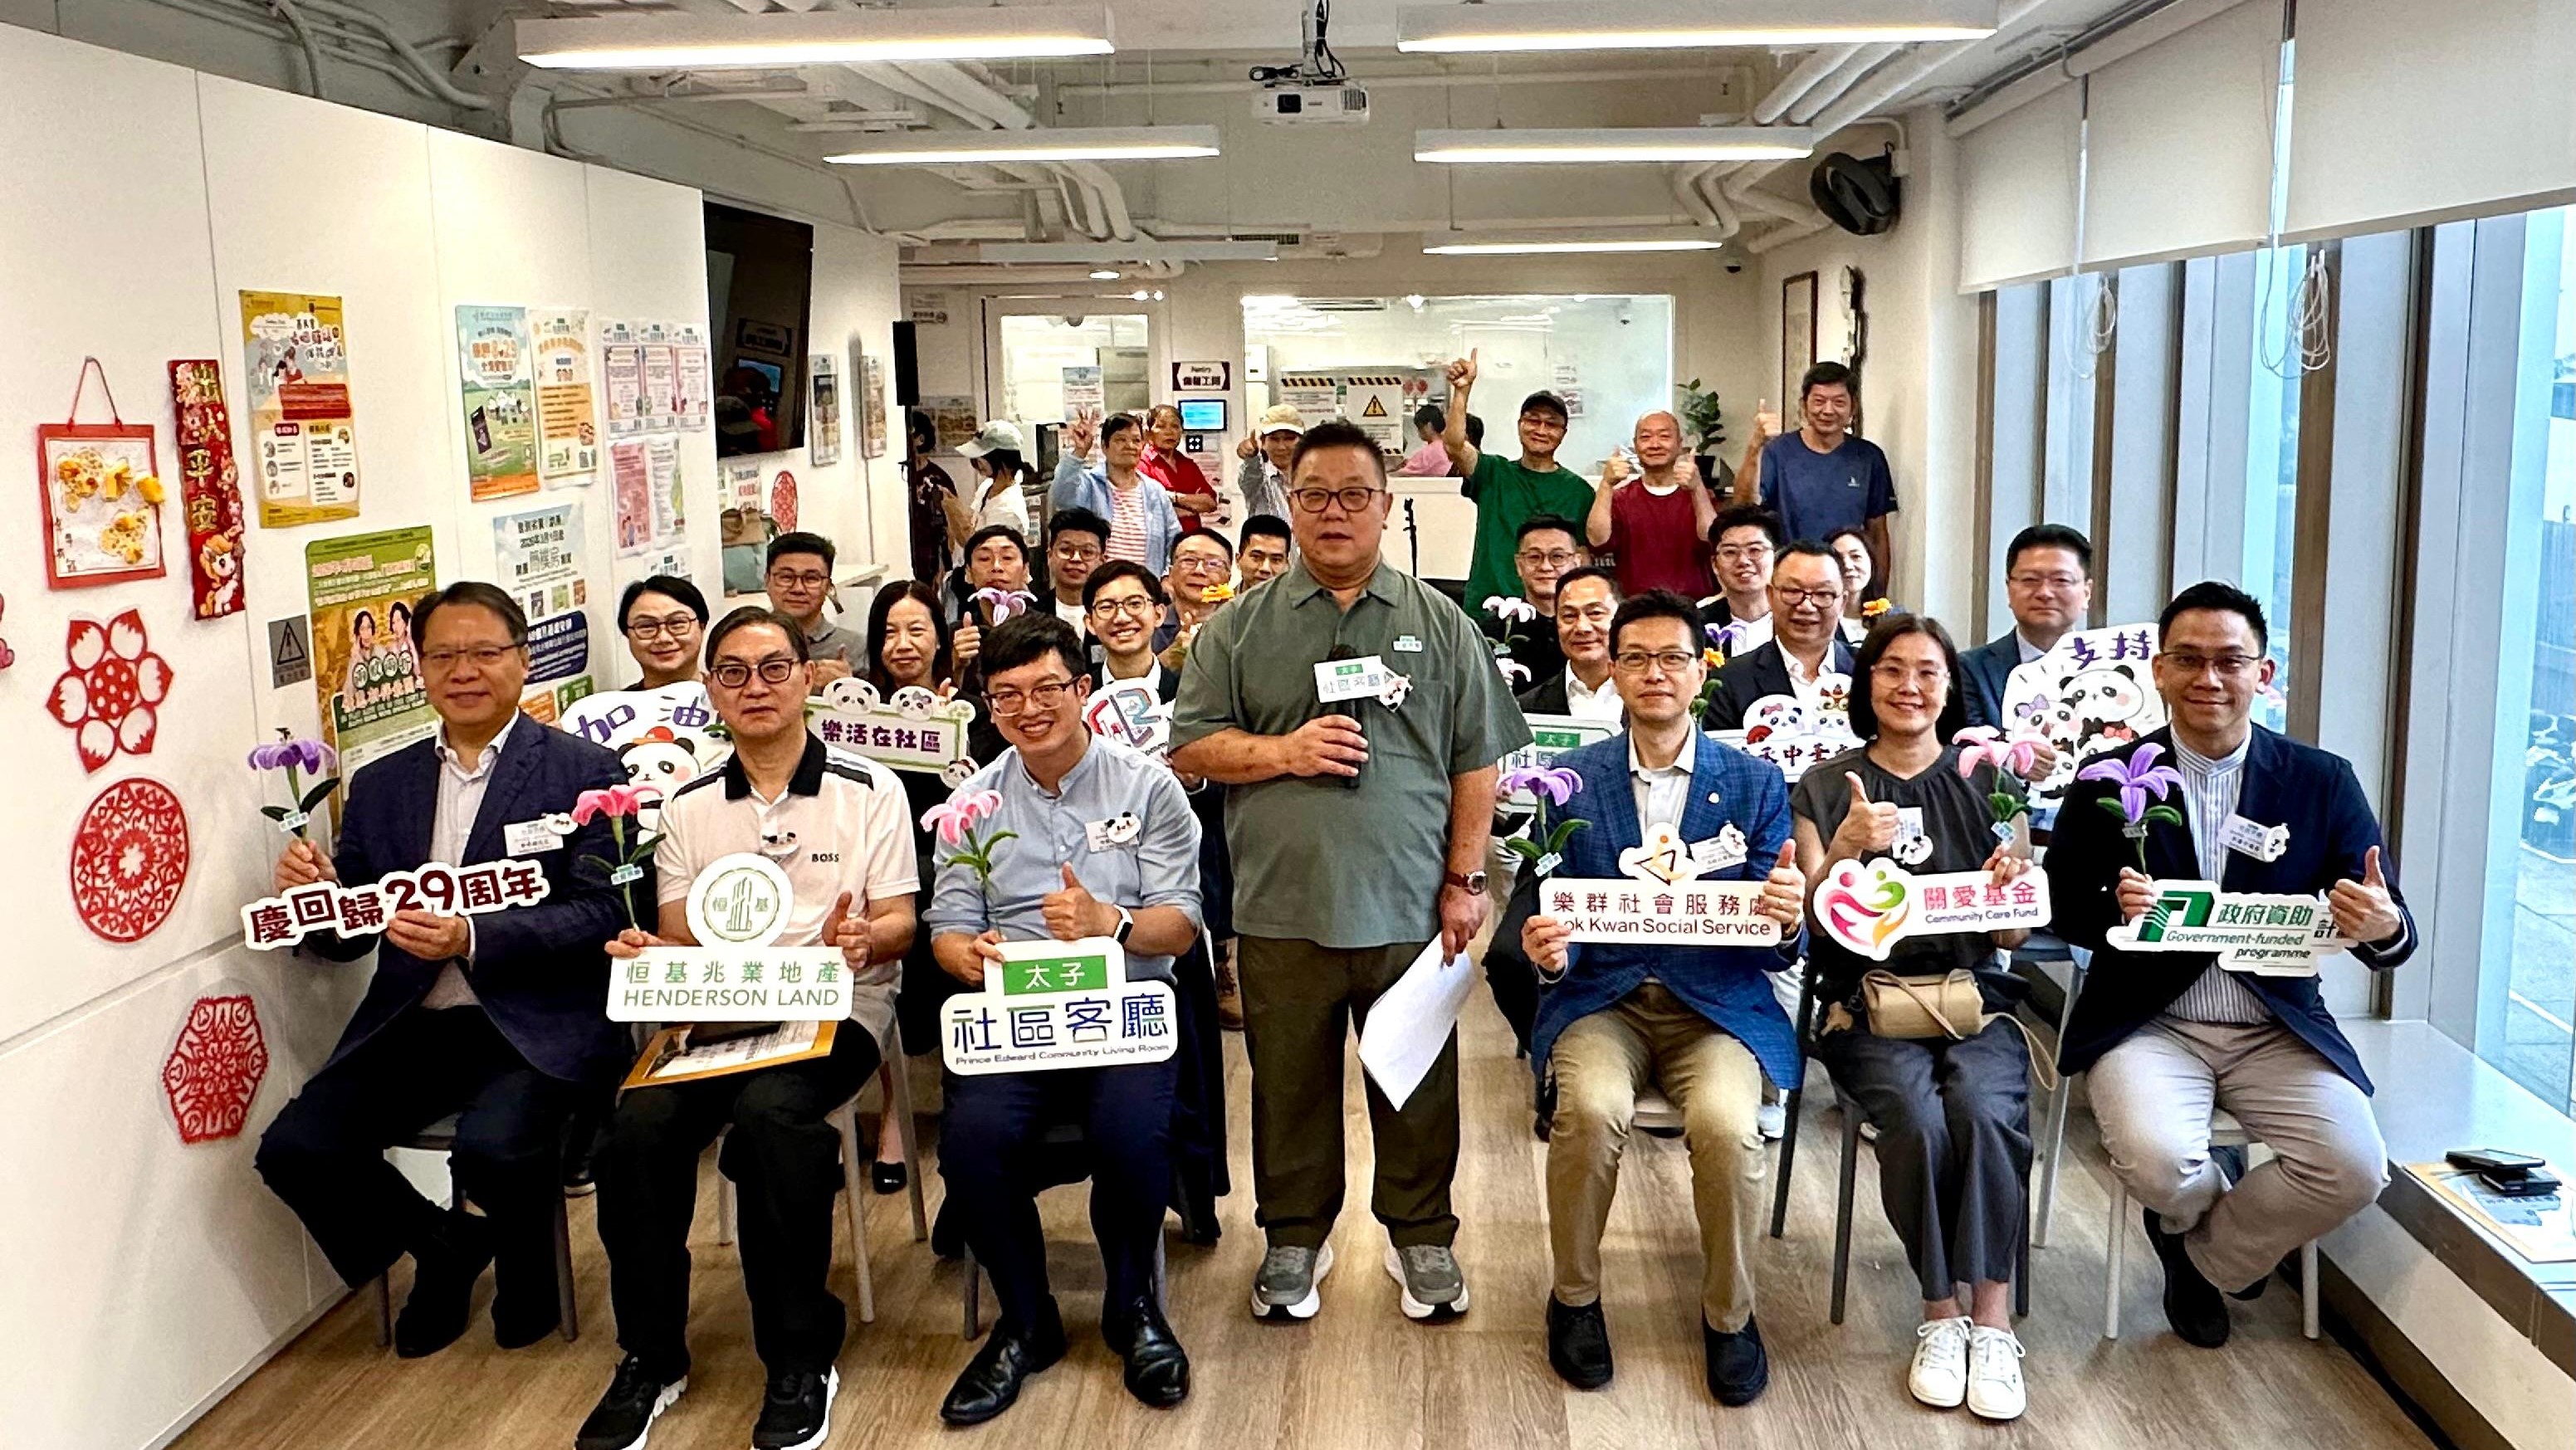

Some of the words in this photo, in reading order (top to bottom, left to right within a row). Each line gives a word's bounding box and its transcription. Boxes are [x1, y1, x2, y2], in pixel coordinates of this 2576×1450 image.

[2063, 628, 2152, 670] 支持
[573, 691, 711, 745] 加油
[821, 719, 941, 754] 樂活在社區
[812, 853, 840, 863] BOSS
[250, 867, 543, 944] 慶回歸29周年
[1923, 881, 2038, 911] 關愛基金
[1924, 911, 1983, 925] Community
[1985, 910, 2011, 921] Care
[2013, 906, 2039, 919] Fund
[2216, 901, 2314, 926] 政府資助
[1562, 916, 1585, 933] ok
[1589, 917, 1640, 934] Kwan
[1642, 918, 1699, 935] Social
[1702, 919, 1771, 937] Service
[2167, 929, 2305, 946] Government-funded
[2234, 947, 2311, 961] programme
[625, 960, 840, 984] 恒基兆業地產
[1024, 961, 1086, 991] 太子
[623, 989, 767, 1008] HENDERSON
[777, 989, 840, 1008] LAND
[951, 993, 1169, 1054] 社區客廳
[956, 1055, 991, 1066] Prince
[995, 1052, 1036, 1063] Edward
[1039, 1048, 1099, 1061] Community
[1102, 1045, 1136, 1056] Living
[1138, 1043, 1170, 1052] Room
